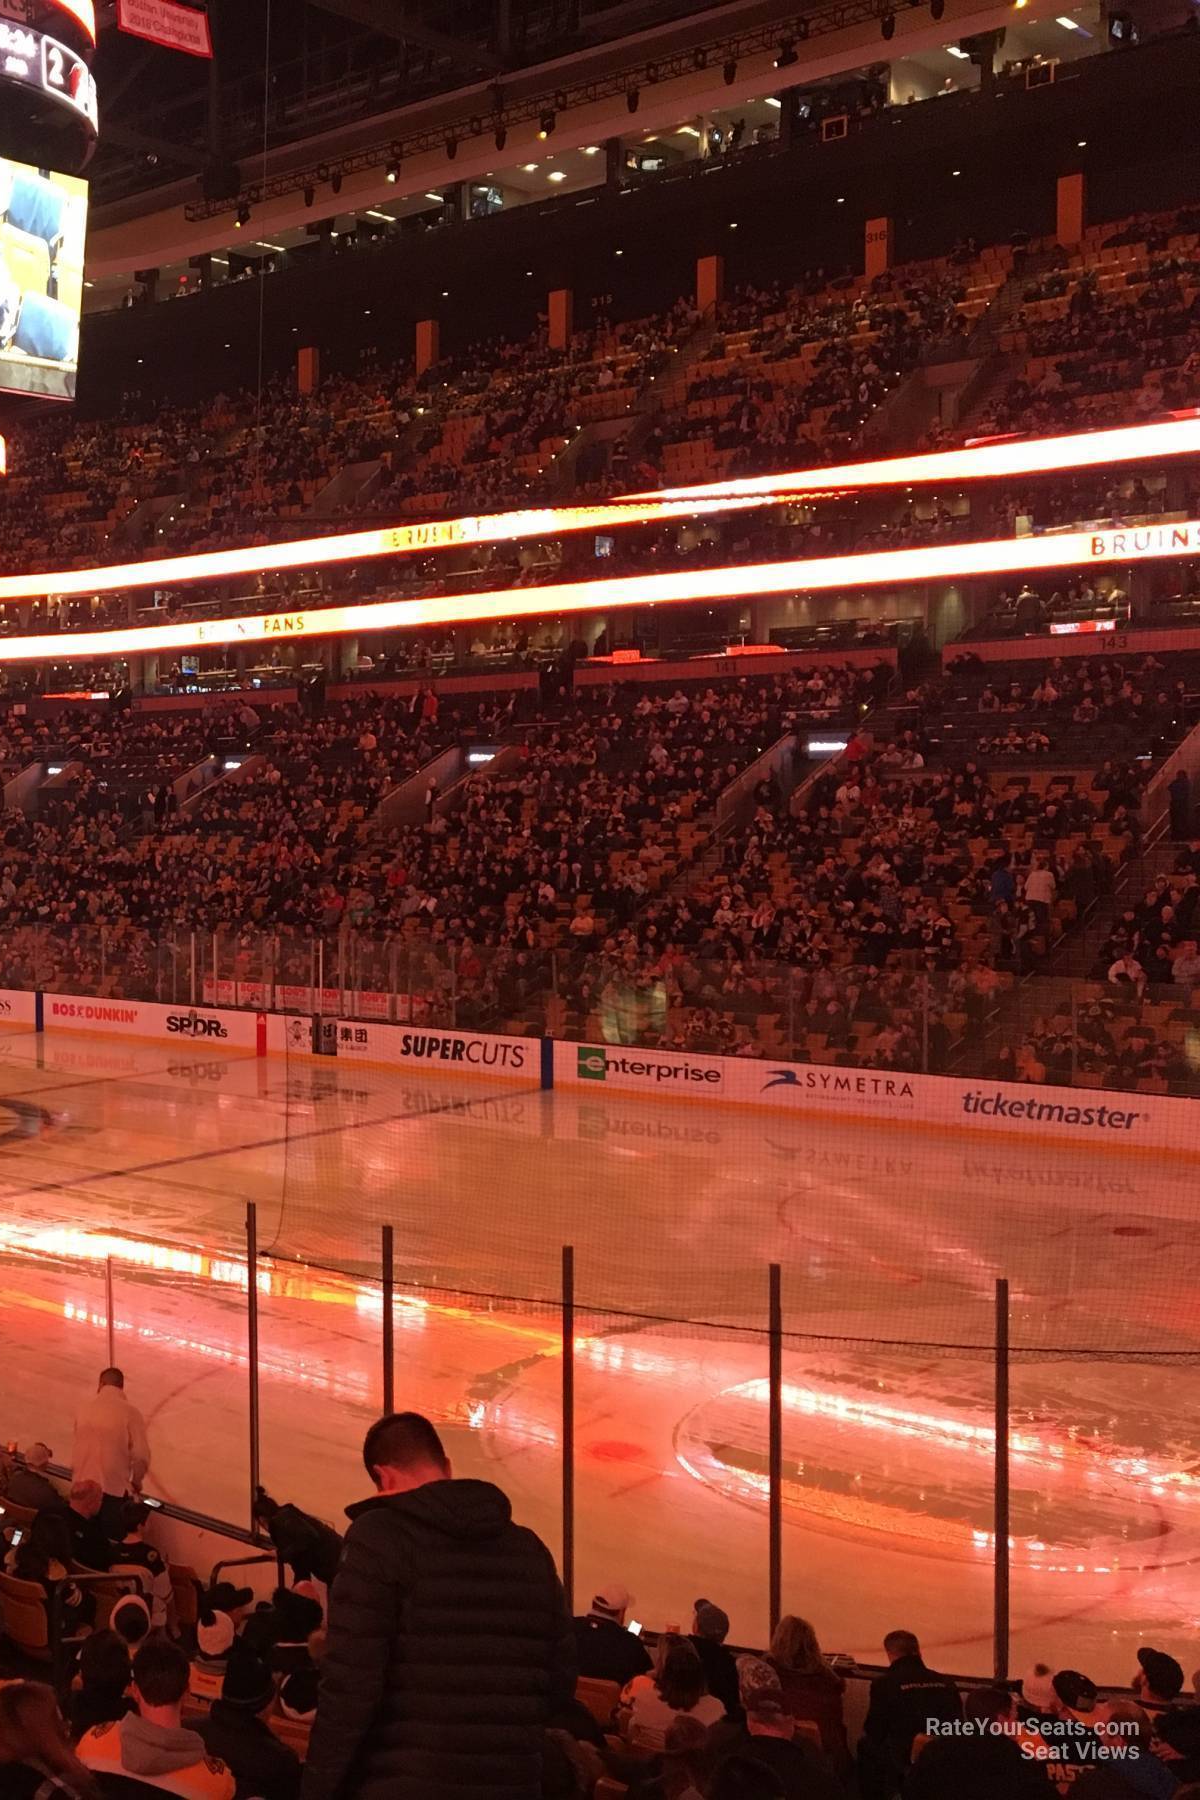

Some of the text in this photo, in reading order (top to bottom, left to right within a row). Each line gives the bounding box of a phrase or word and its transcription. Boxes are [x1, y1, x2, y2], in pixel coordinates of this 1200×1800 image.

[48, 47, 64, 85] 2
[1091, 529, 1200, 556] BRUIN
[263, 616, 305, 632] FANS
[1102, 636, 1128, 649] 143
[401, 1034, 525, 1068] SUPERCUTS
[586, 1055, 721, 1084] enterprise
[806, 1072, 914, 1098] SYMETRA
[962, 1091, 1140, 1130] ticketmaster
